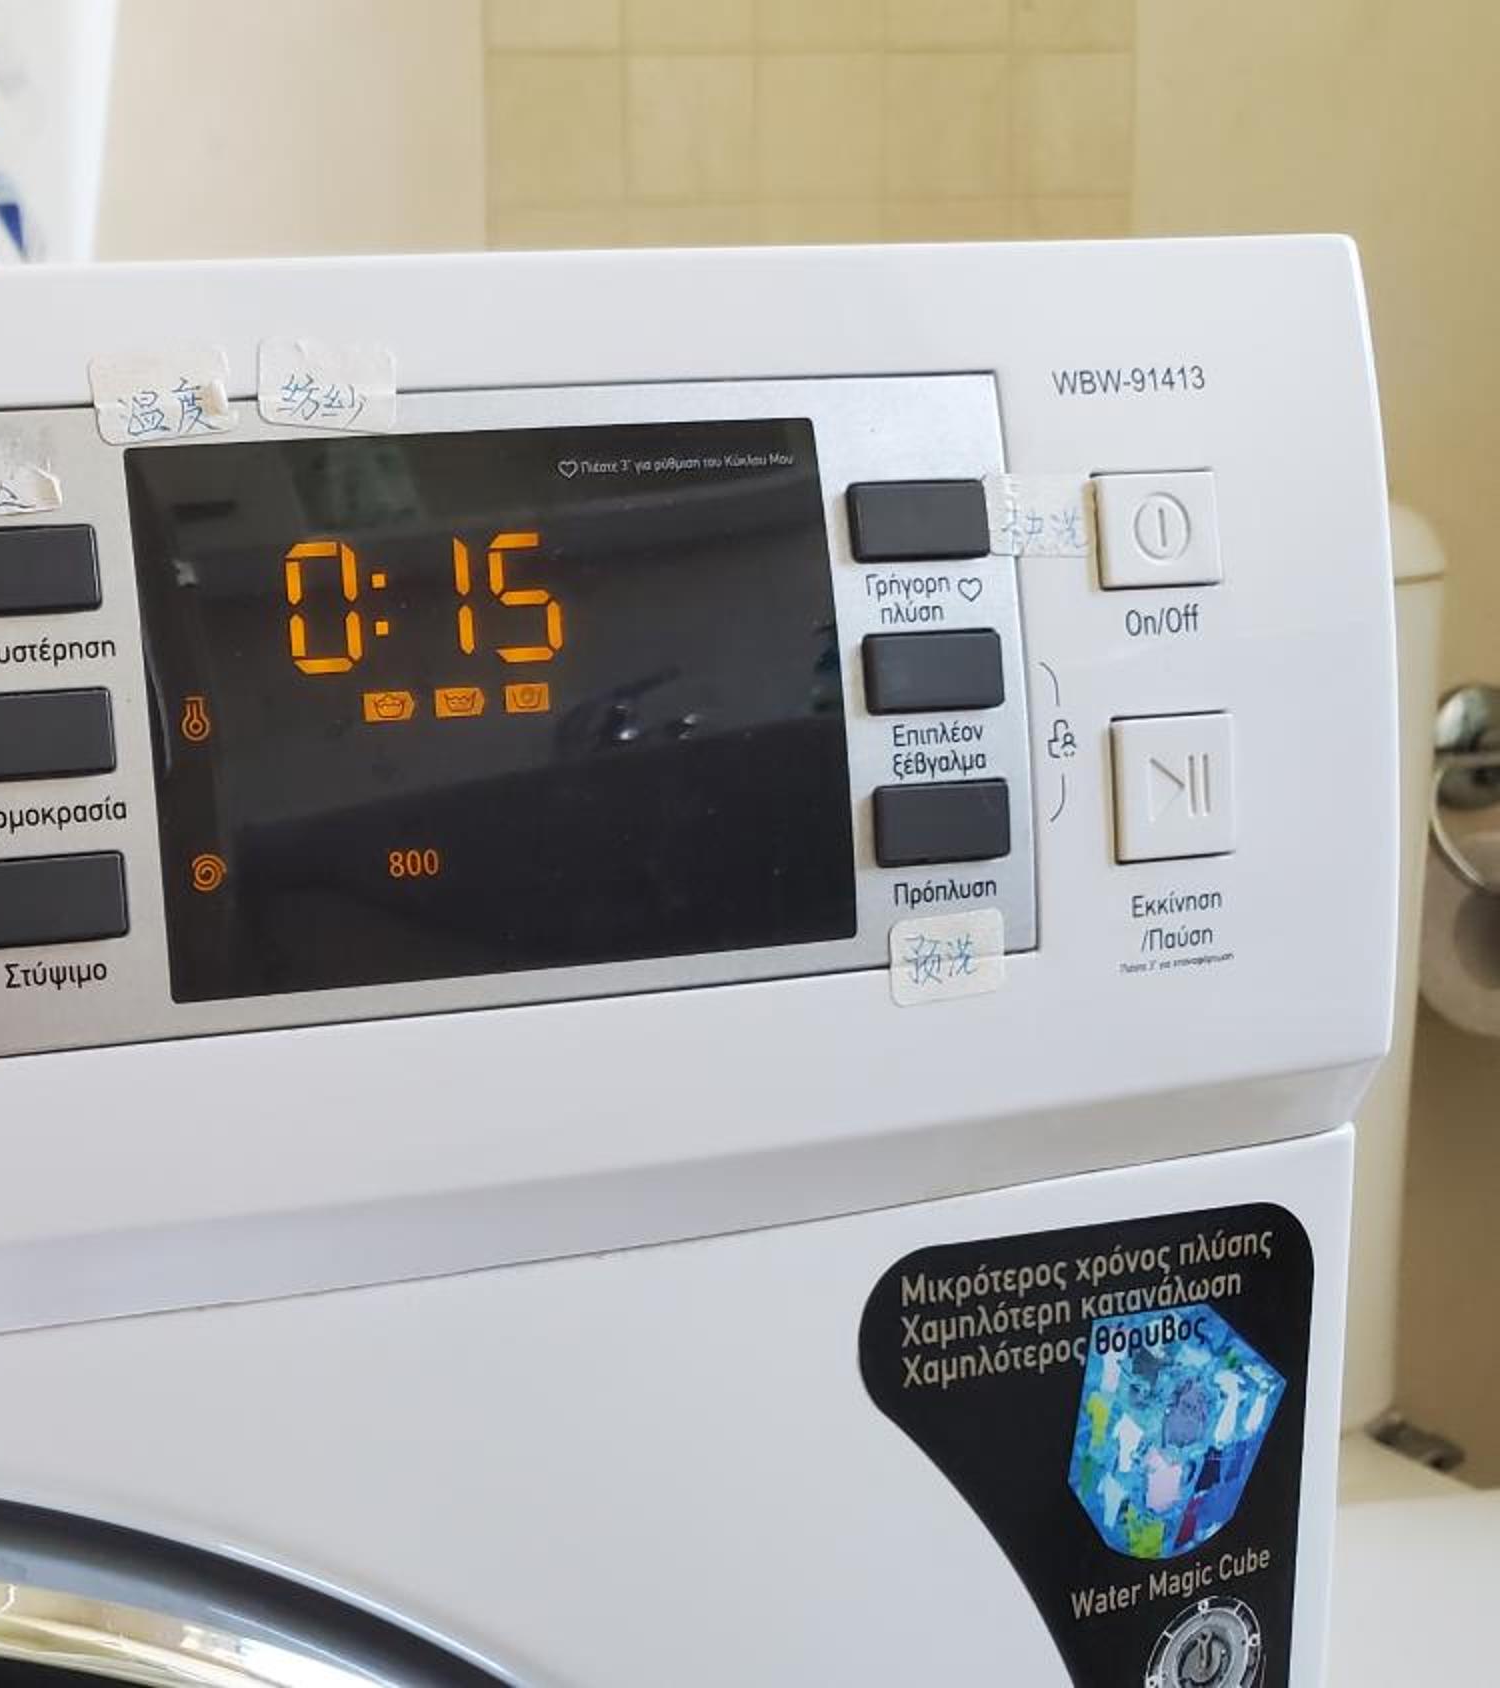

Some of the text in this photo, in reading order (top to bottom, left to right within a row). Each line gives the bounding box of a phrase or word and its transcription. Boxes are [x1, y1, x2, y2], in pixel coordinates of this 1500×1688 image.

[1052, 365, 1206, 395] WBW-91413
[866, 573, 950, 601] Γρήγορη
[285, 532, 564, 675] 0:15
[881, 602, 943, 624] πλύση
[1125, 604, 1200, 637] On/Off
[893, 724, 983, 747] Επιπλέον
[893, 750, 986, 778] ξέβγαλμα
[389, 849, 439, 877] 800
[894, 878, 997, 909] Πρόπλυση
[1131, 890, 1222, 918] Εκκίνηση
[1141, 925, 1213, 953] /Παύση
[4, 961, 106, 991] Στύψιμο
[902, 1228, 1273, 1307] Μικρότερος χρόνος πλύσης
[902, 1271, 1241, 1347] Χαμηλότερη κατανάλωση
[903, 1313, 1207, 1388] Χαμηλότερος θόρυβος
[1071, 1547, 1270, 1620] Water Magic Cube
